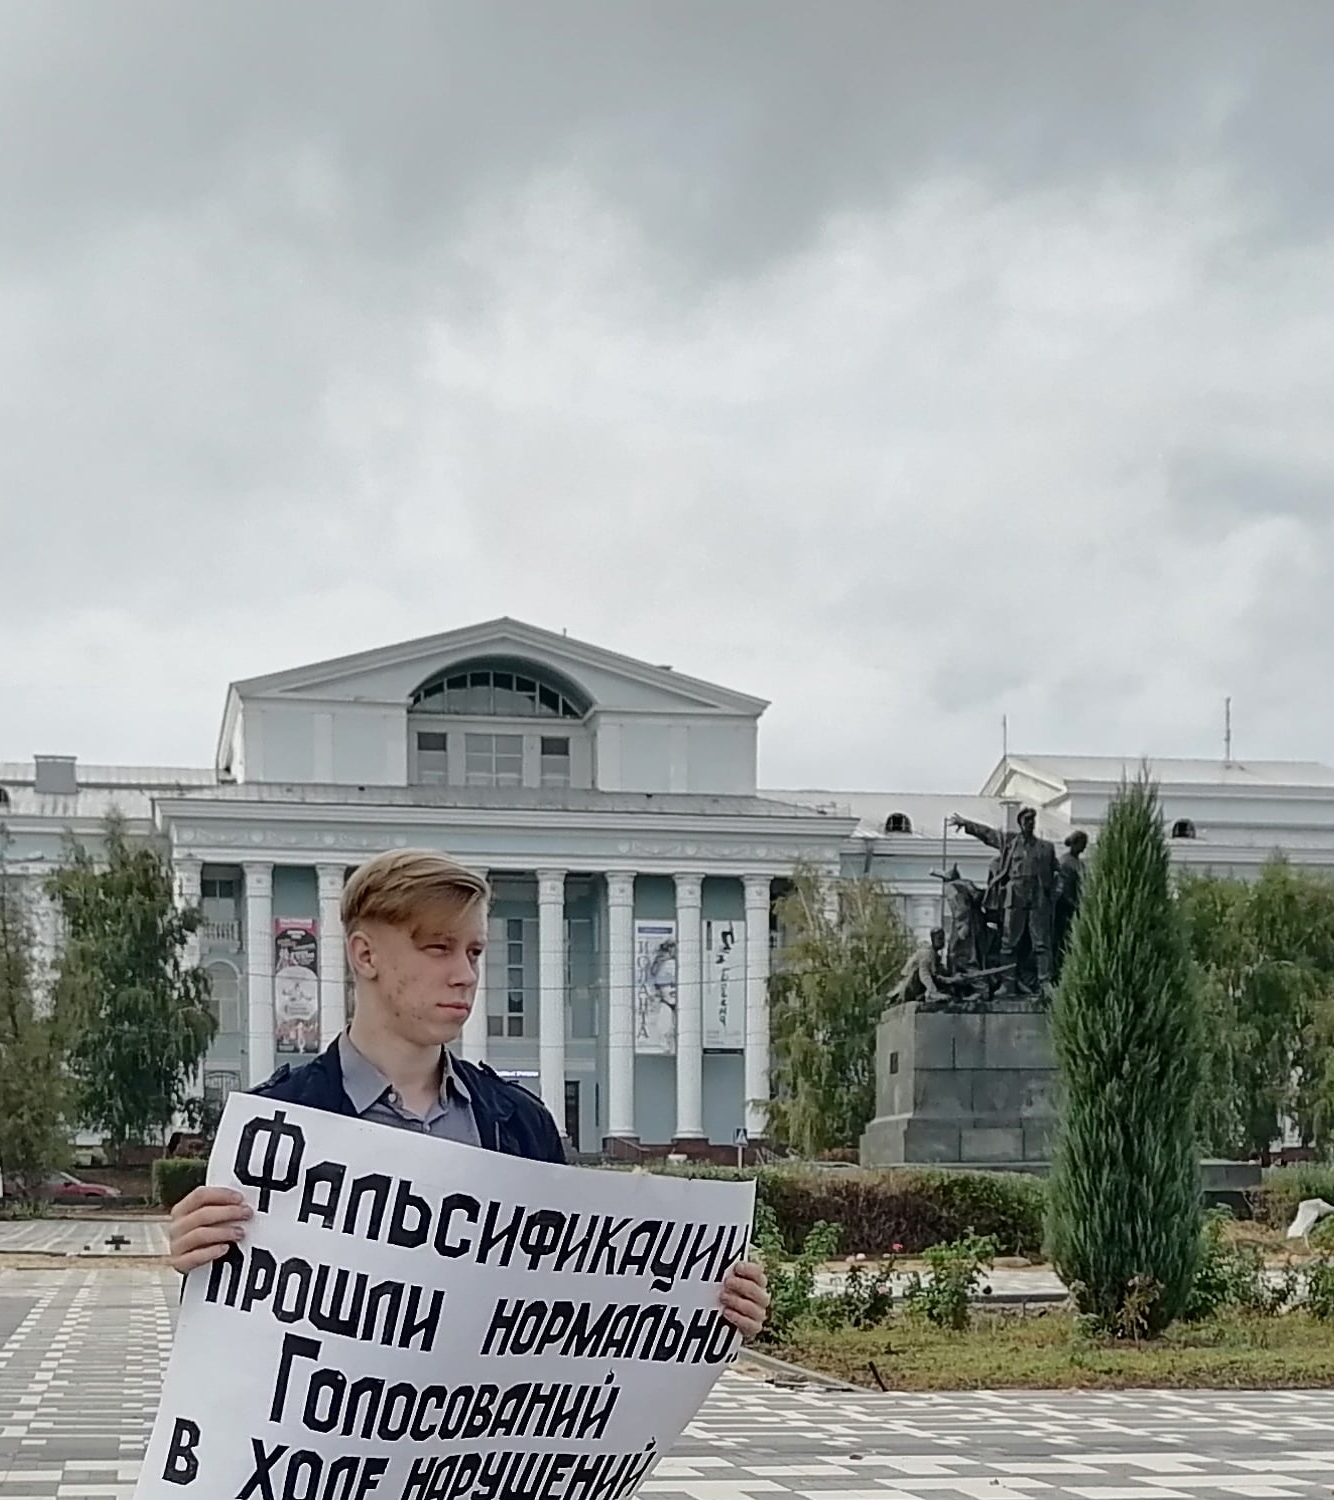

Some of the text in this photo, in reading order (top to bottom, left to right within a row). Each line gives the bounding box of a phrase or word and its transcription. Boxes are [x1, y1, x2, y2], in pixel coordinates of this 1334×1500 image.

[234, 1110, 749, 1291] ФАЛЬСИФИКАЦИИ
[205, 1242, 445, 1352] ПРОШЛИ
[269, 1332, 620, 1442] ГОЛОСОВАНИЙ
[161, 1417, 201, 1485] В
